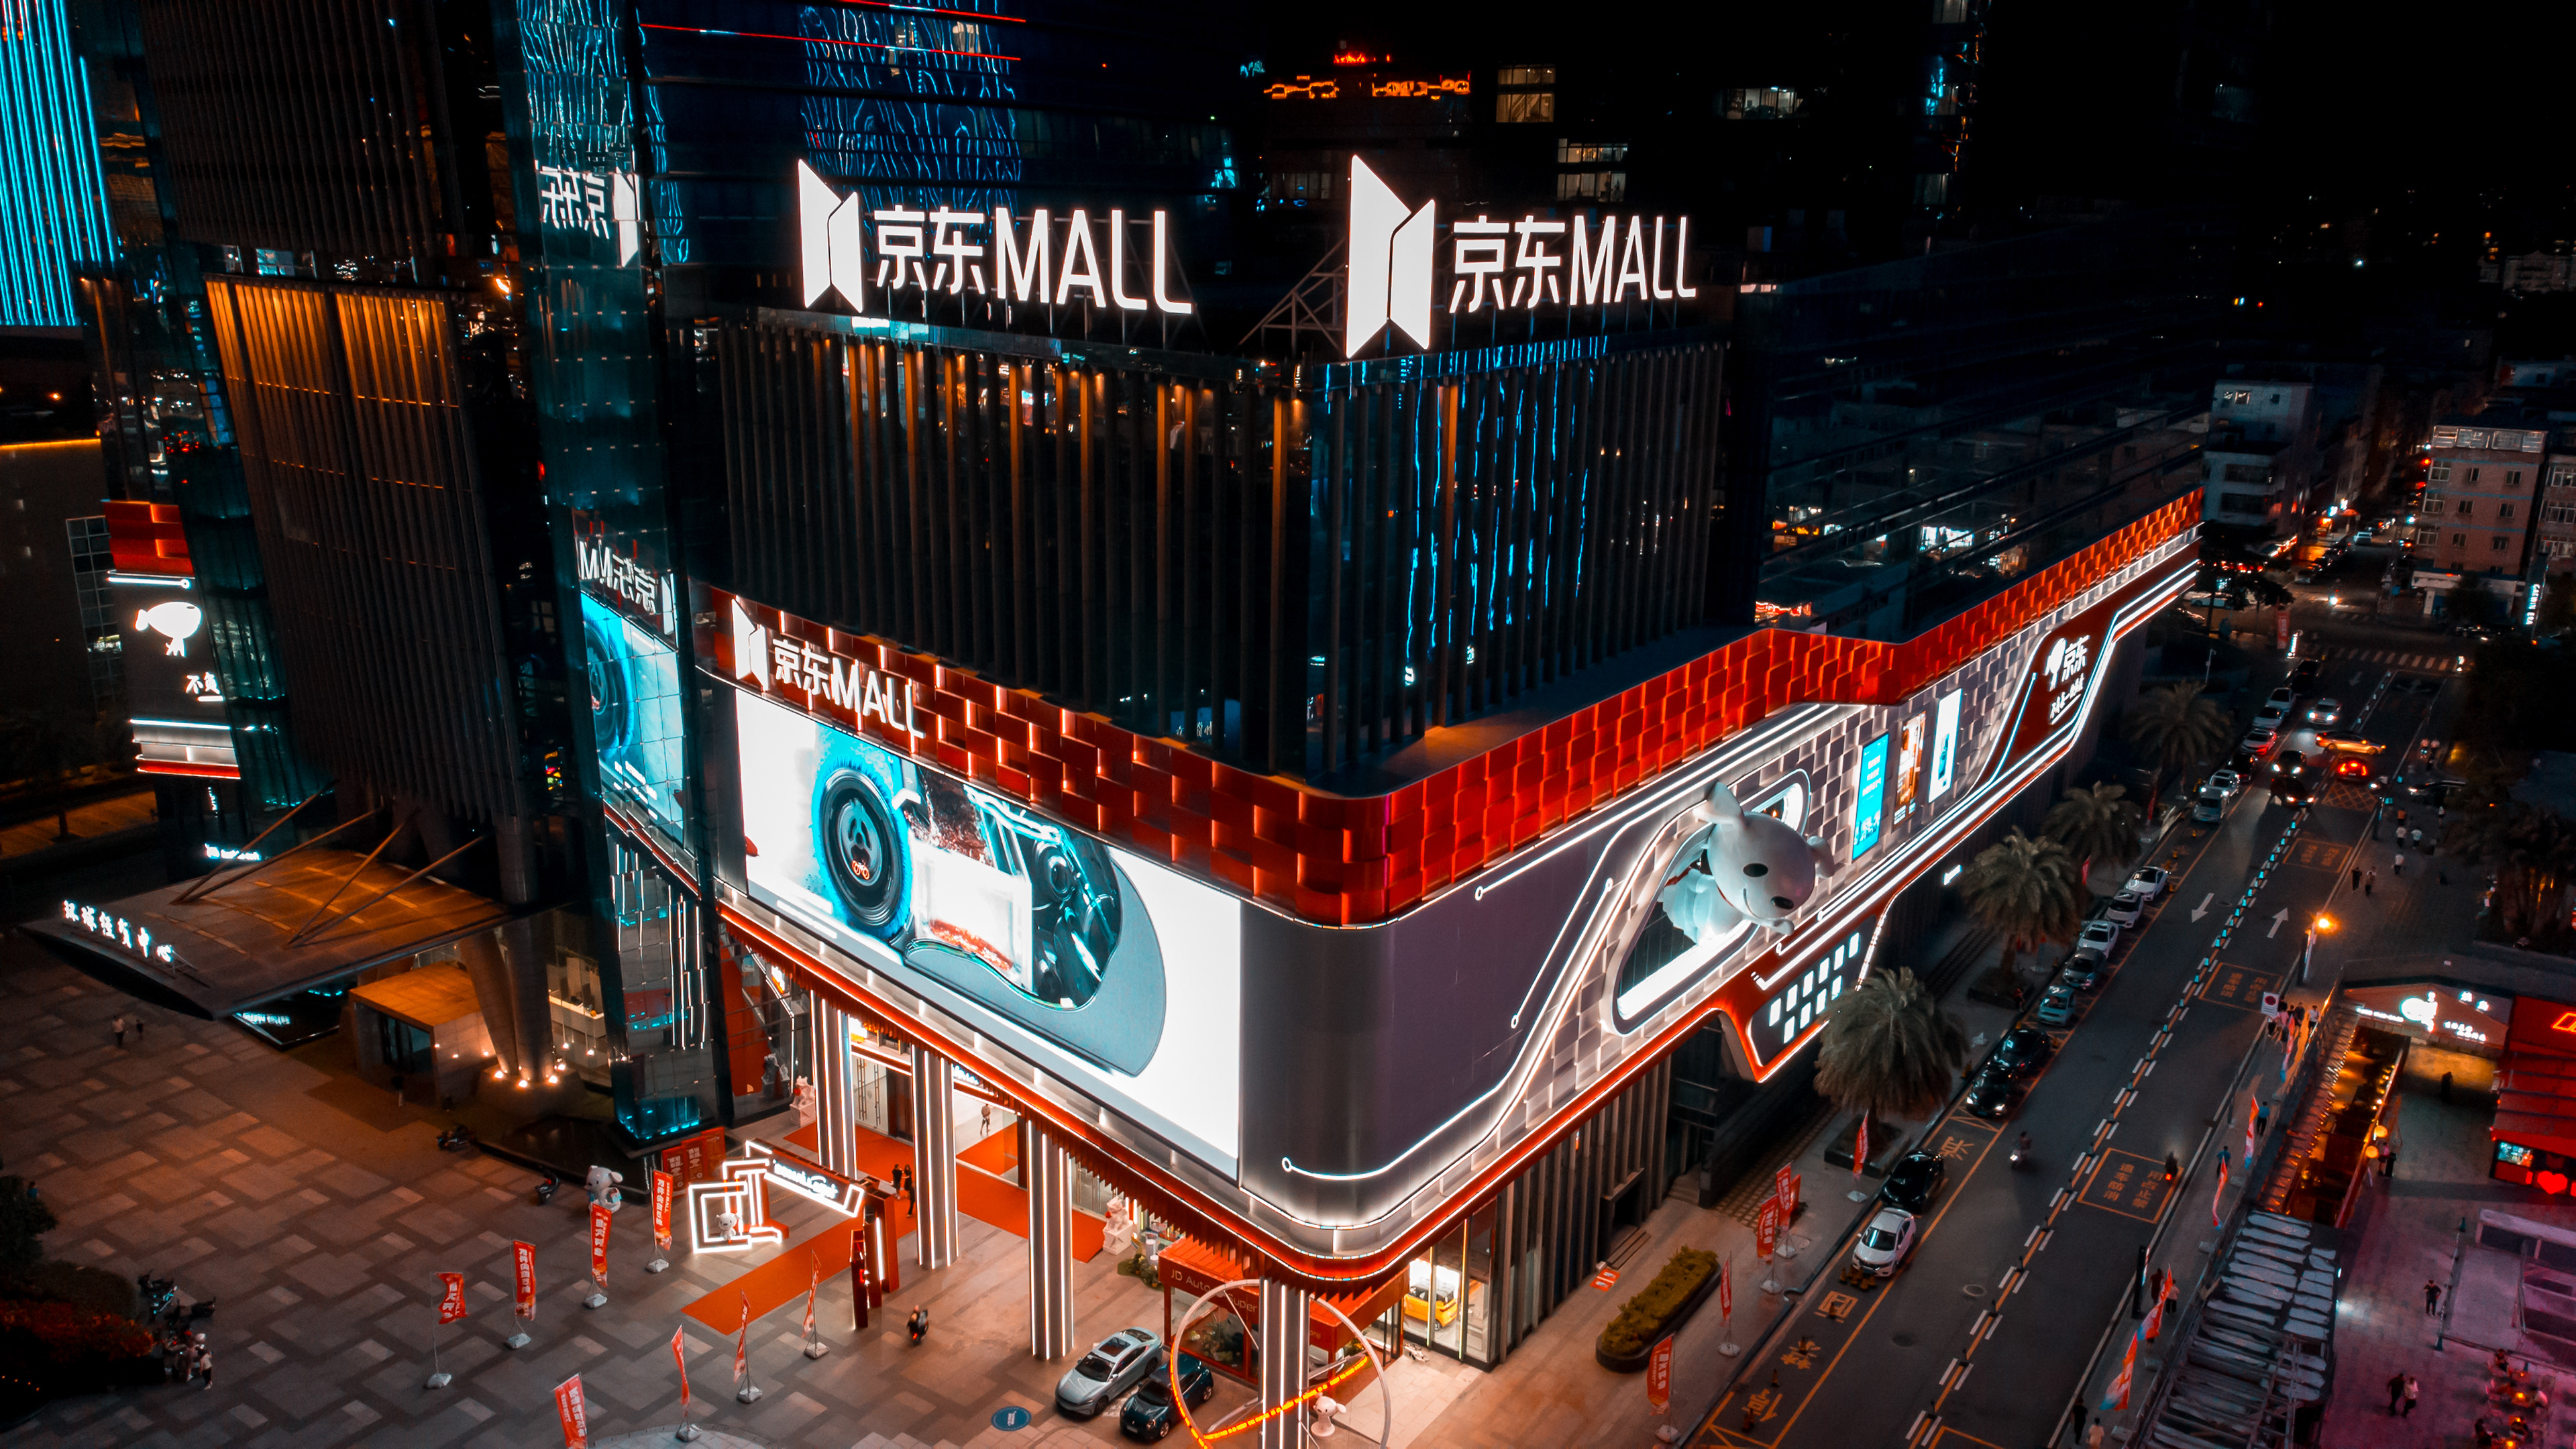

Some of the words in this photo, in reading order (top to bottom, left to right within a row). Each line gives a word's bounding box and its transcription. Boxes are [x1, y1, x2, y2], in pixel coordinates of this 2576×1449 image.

[2061, 635, 2090, 682] 京东
[1171, 1269, 1183, 1282] JD
[1185, 1275, 1211, 1293] Auto
